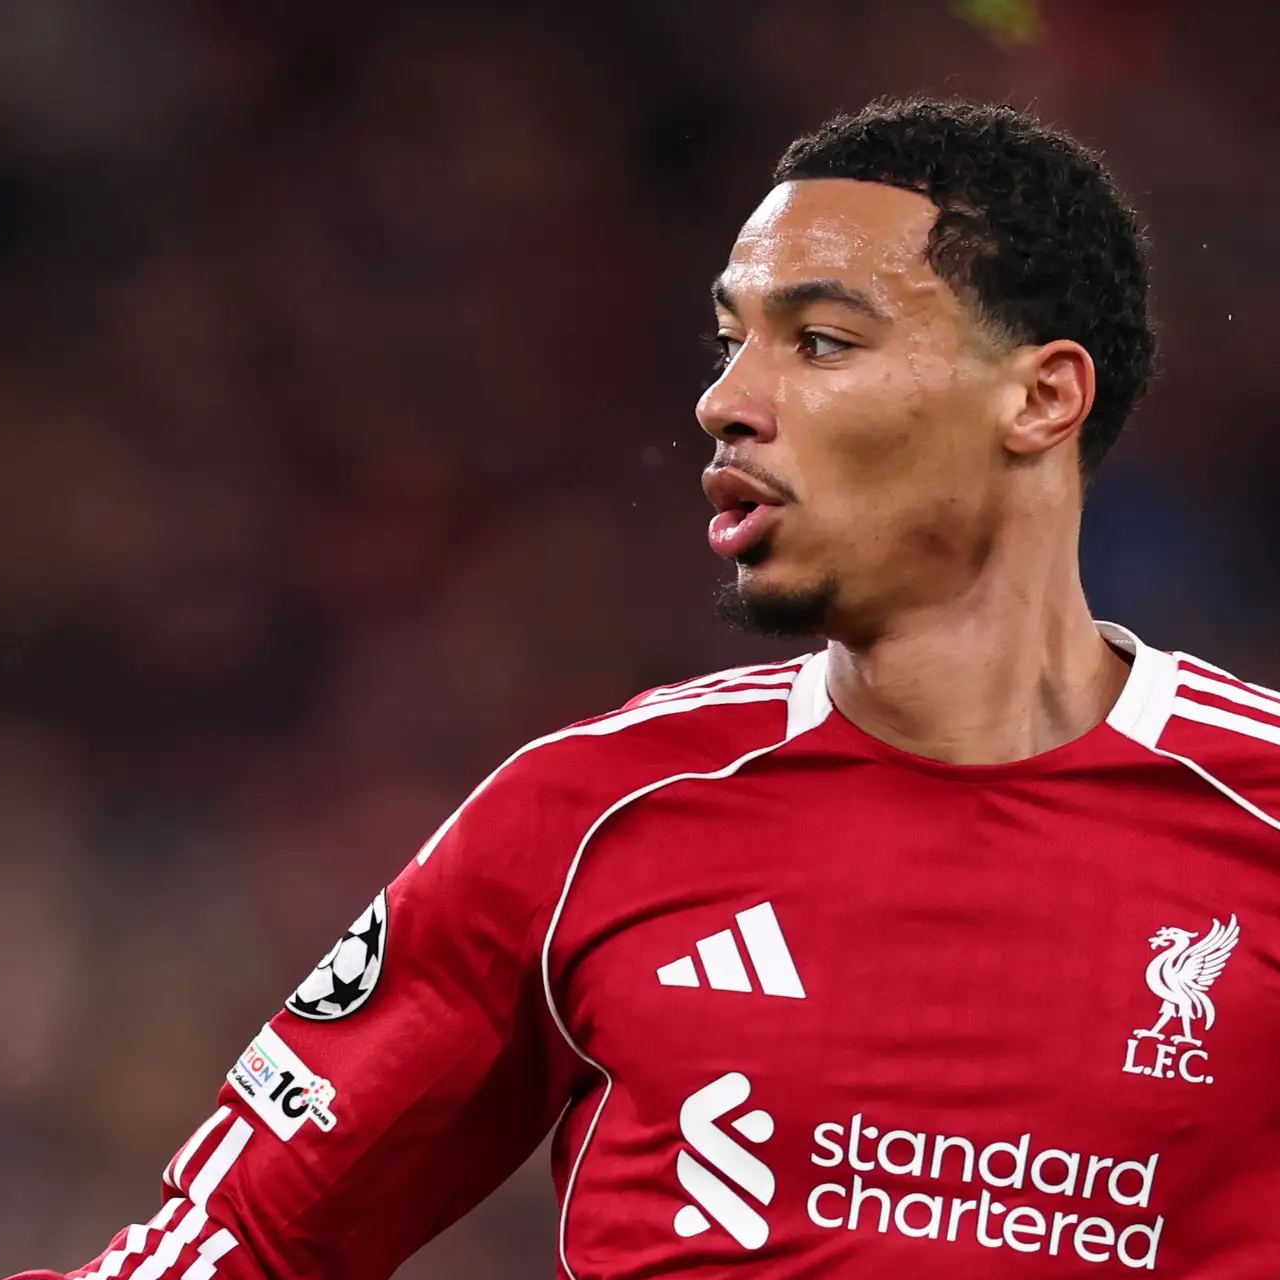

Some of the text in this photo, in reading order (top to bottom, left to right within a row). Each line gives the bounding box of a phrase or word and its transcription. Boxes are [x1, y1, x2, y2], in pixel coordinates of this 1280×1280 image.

[1122, 1039, 1214, 1084] L.F.C.
[269, 1071, 310, 1118] 10
[310, 1105, 330, 1126] YEARS
[809, 1112, 1160, 1208] standard
[806, 1174, 1165, 1270] chartered
